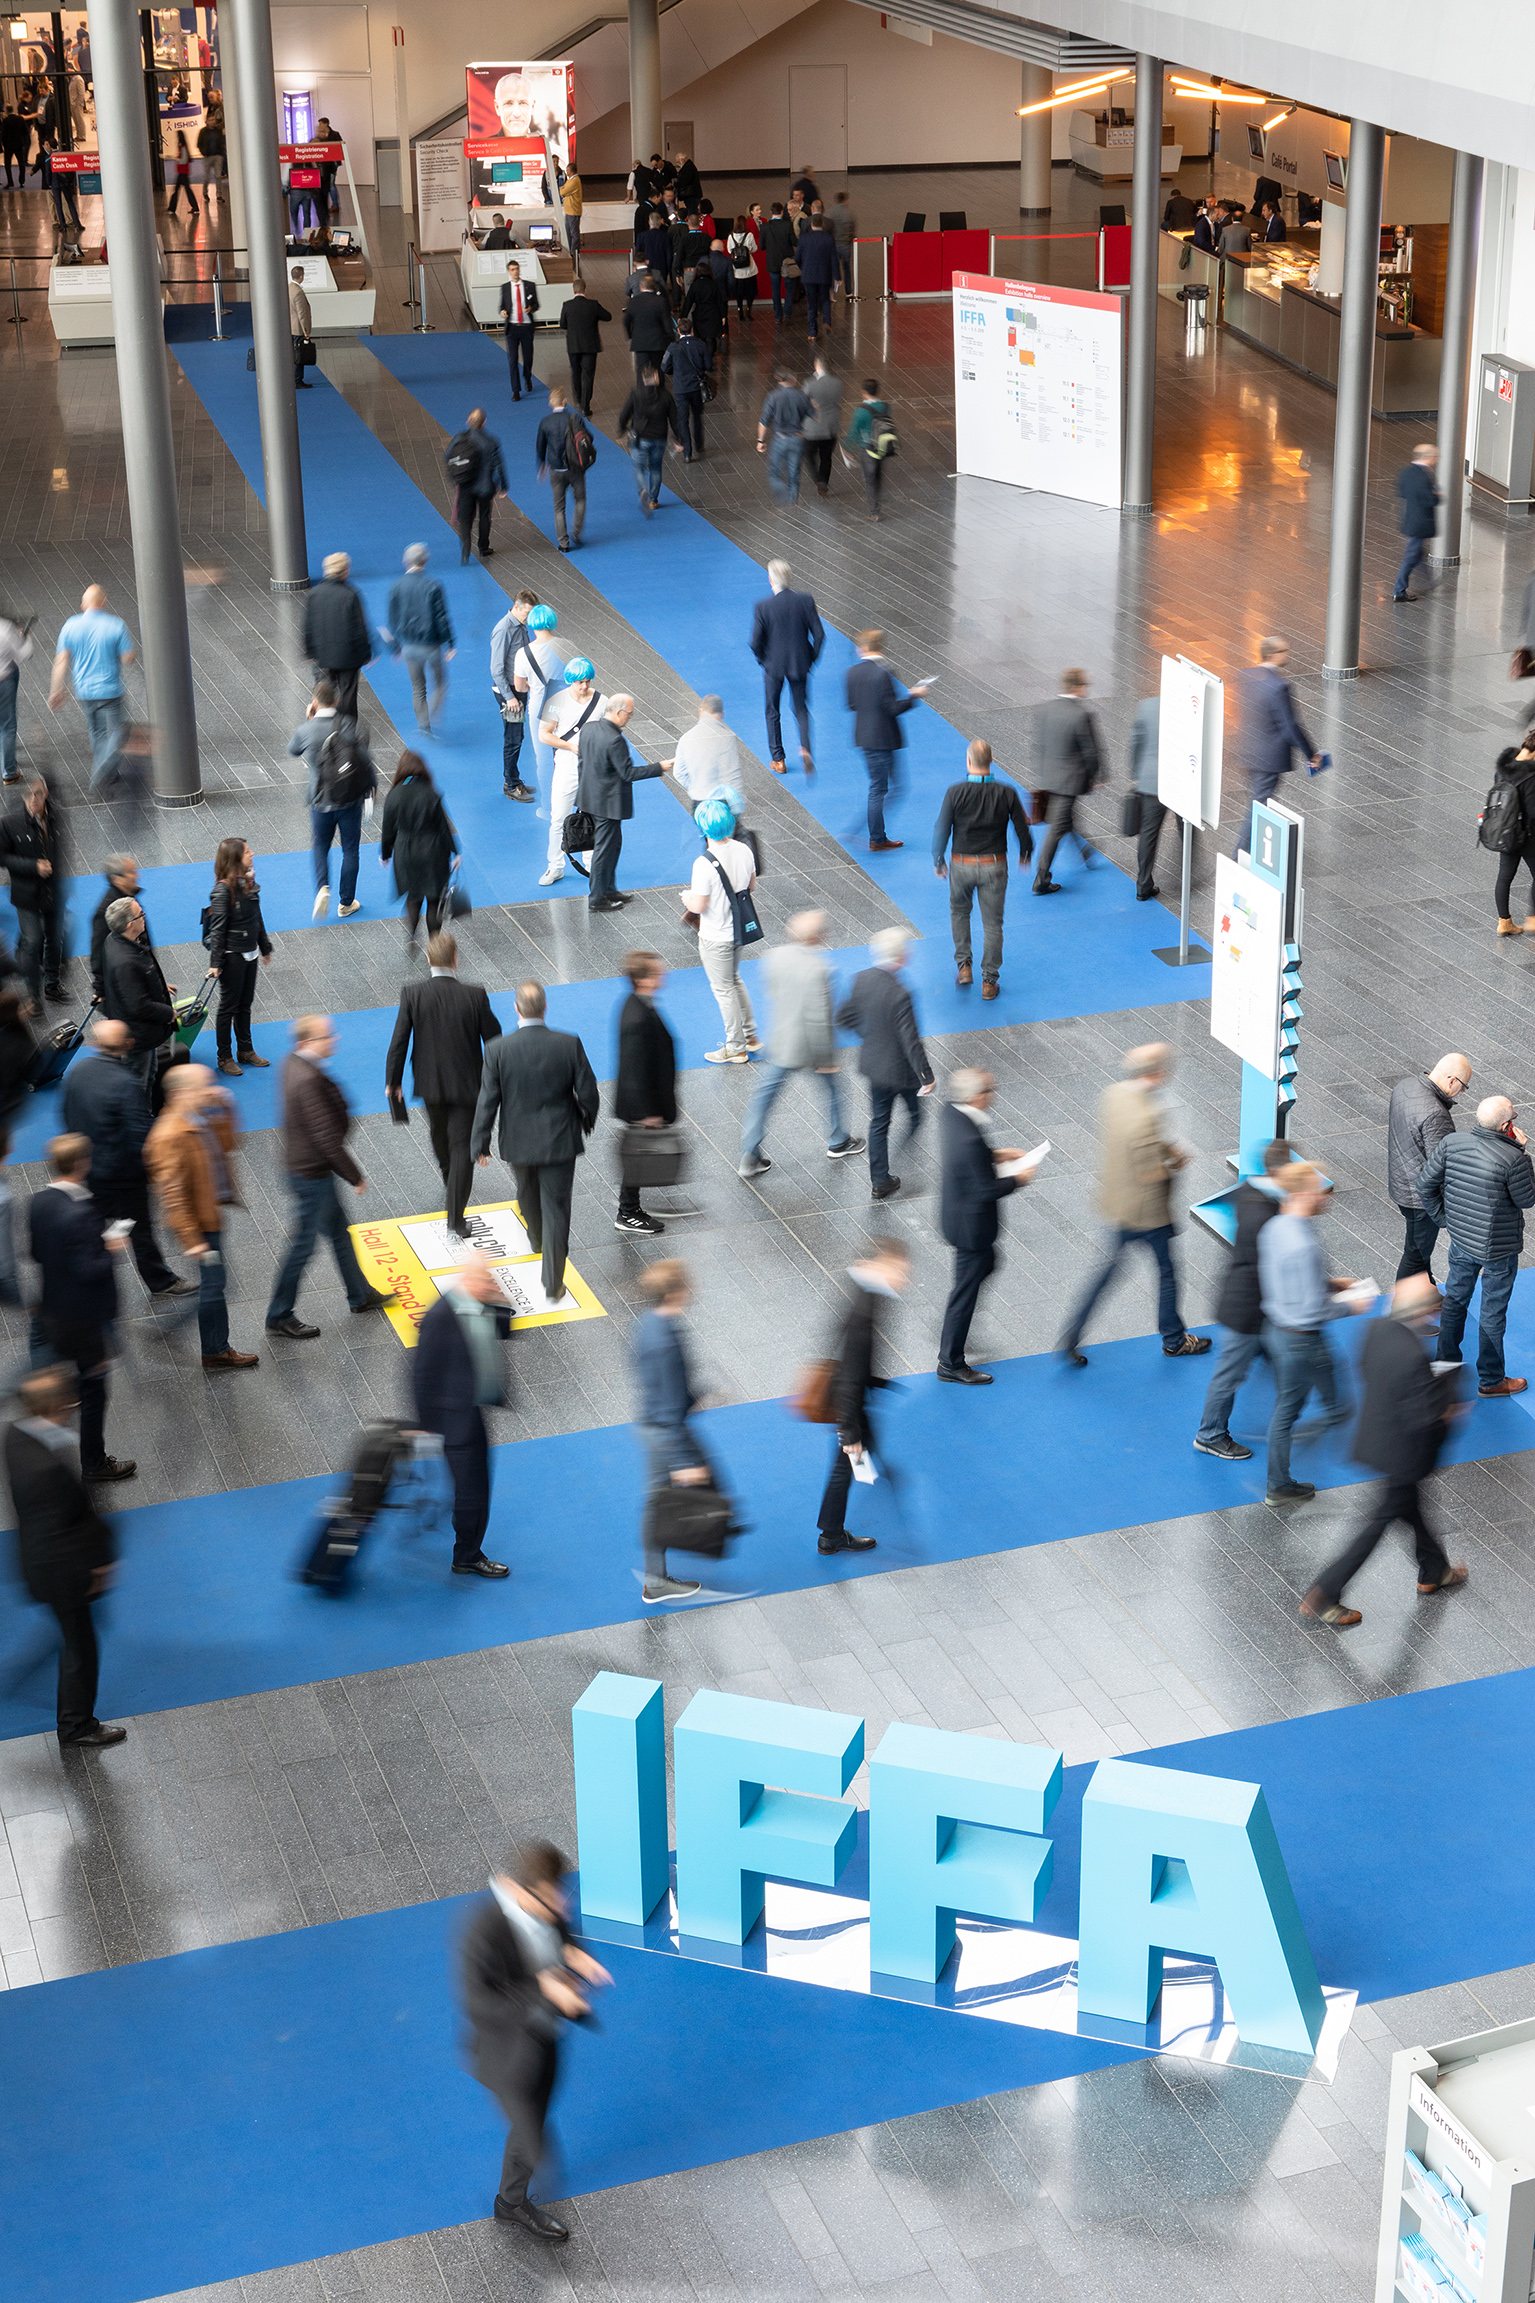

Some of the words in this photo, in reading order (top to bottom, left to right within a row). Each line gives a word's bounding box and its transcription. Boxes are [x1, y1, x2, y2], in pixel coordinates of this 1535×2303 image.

[174, 120, 198, 129] ISHIDA
[1272, 153, 1282, 169] Café
[1283, 157, 1297, 175] Portal
[975, 297, 998, 305] willkommen
[1005, 288, 1024, 297] Exhibition
[960, 309, 986, 326] IFFA
[358, 1228, 390, 1251] Hall
[373, 1251, 399, 1266] 12
[387, 1274, 426, 1311] Stand
[496, 1267, 531, 1306] EXCELLENCE
[521, 1305, 536, 1315] IN
[572, 1671, 1328, 2055] IFFA
[1420, 2092, 1481, 2169] Information
